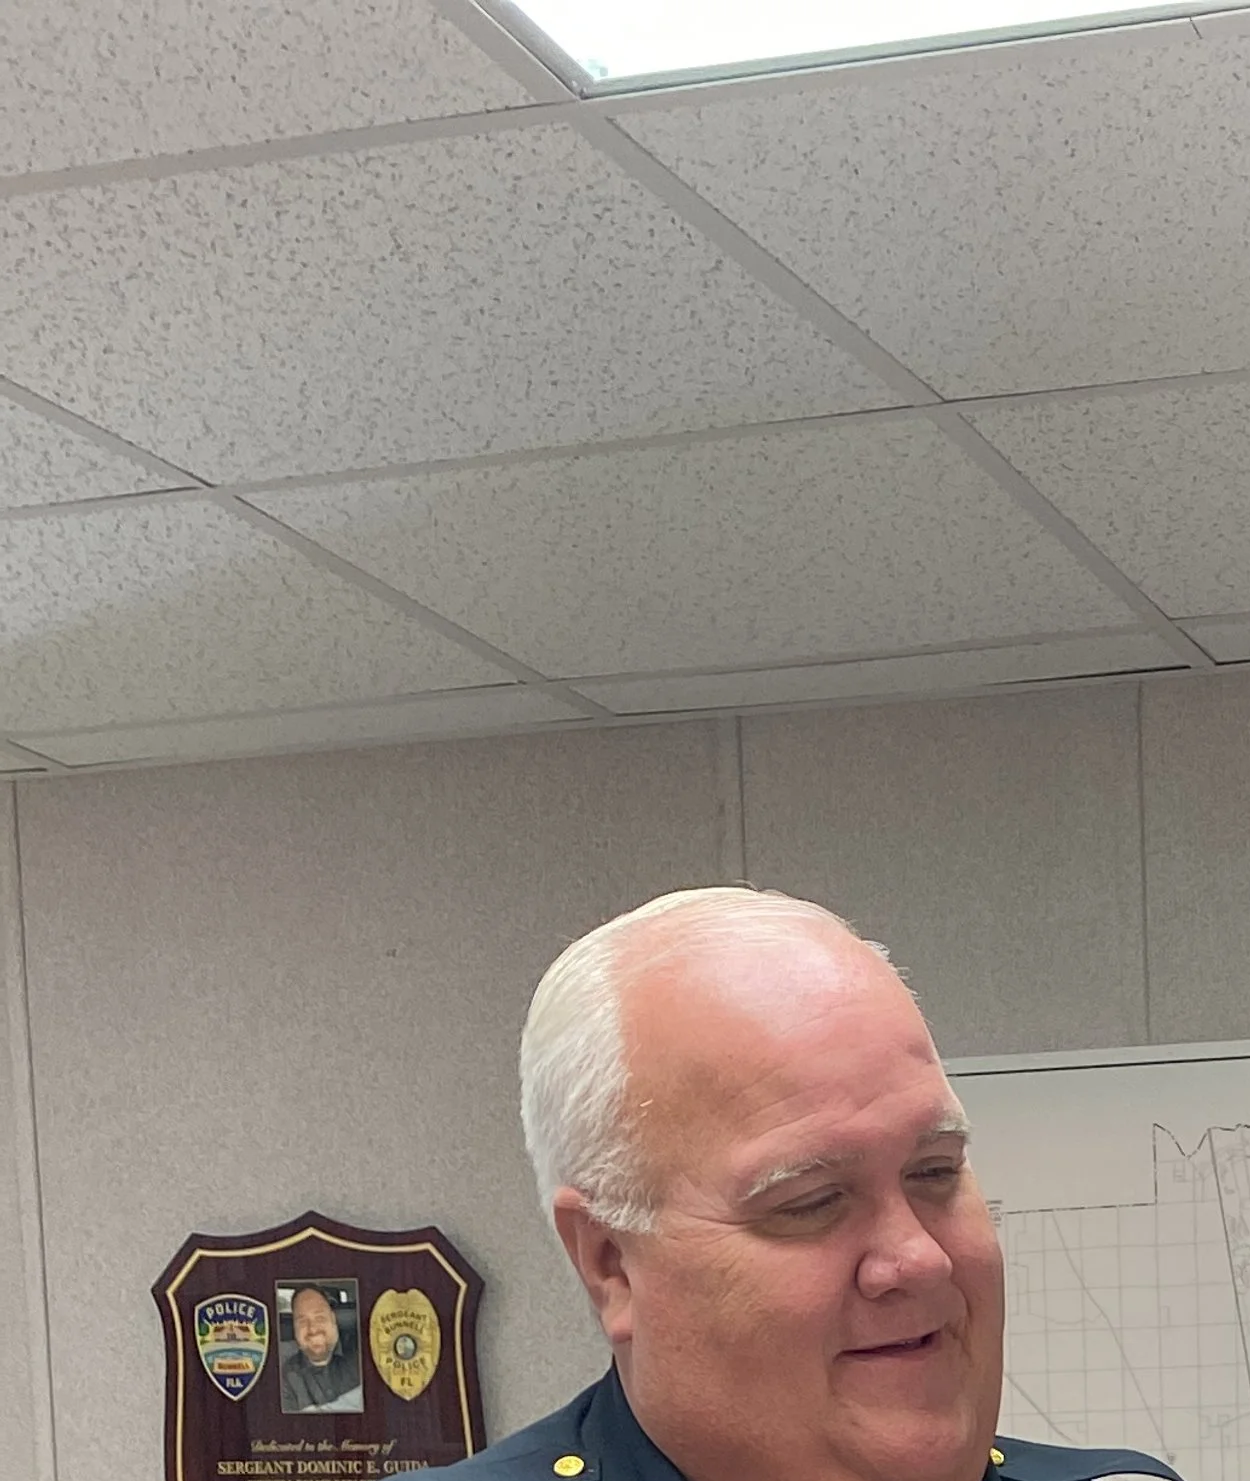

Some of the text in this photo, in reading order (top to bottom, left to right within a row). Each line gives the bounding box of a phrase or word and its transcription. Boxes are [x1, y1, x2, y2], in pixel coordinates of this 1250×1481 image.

[205, 1301, 256, 1320] POLICE
[386, 1356, 428, 1371] POLICE
[400, 1377, 414, 1387] FL
[217, 1460, 294, 1475] SERGEANT
[297, 1460, 362, 1474] DOMINIC
[366, 1460, 380, 1474] E.
